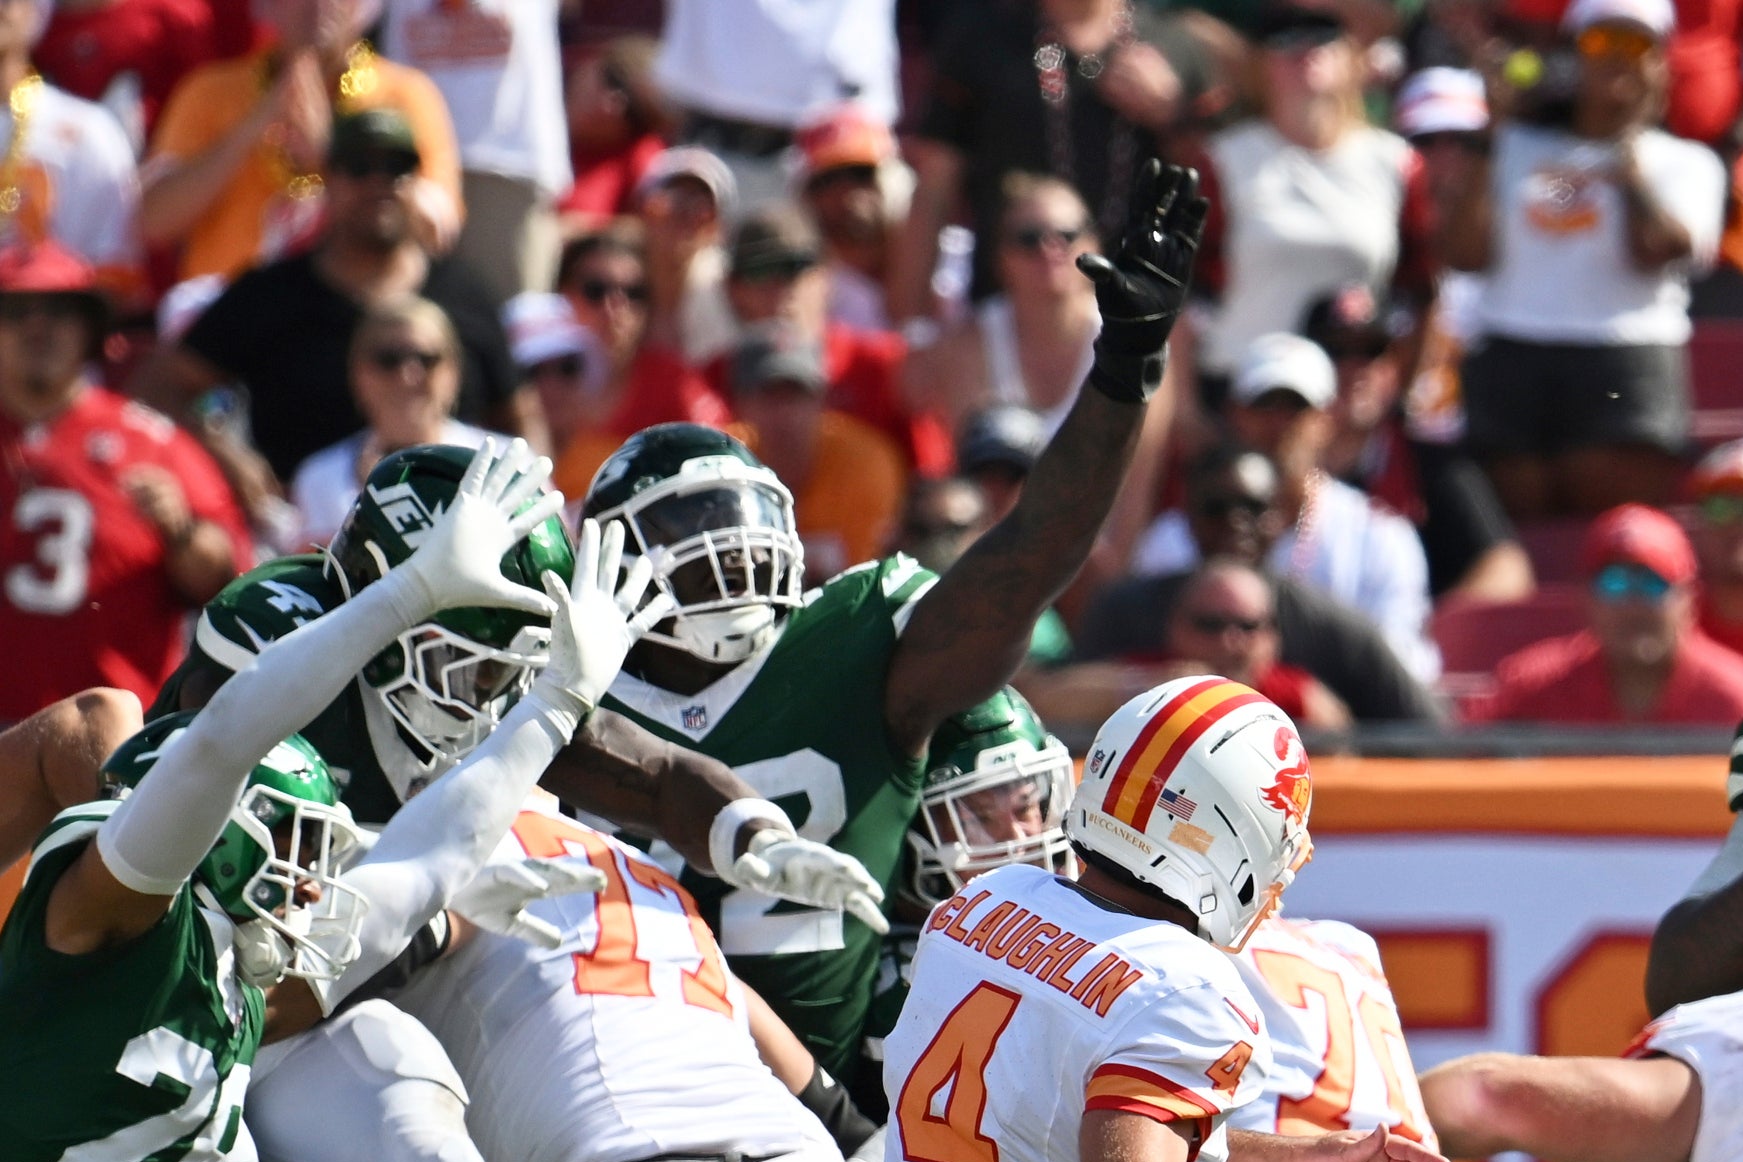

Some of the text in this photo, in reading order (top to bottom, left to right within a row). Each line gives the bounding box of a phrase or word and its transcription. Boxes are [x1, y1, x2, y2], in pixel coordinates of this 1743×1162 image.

[5, 487, 95, 614] 3
[1088, 812, 1152, 855] BUCCANEERS
[511, 811, 734, 1020] 77
[1205, 1040, 1254, 1103] 4
